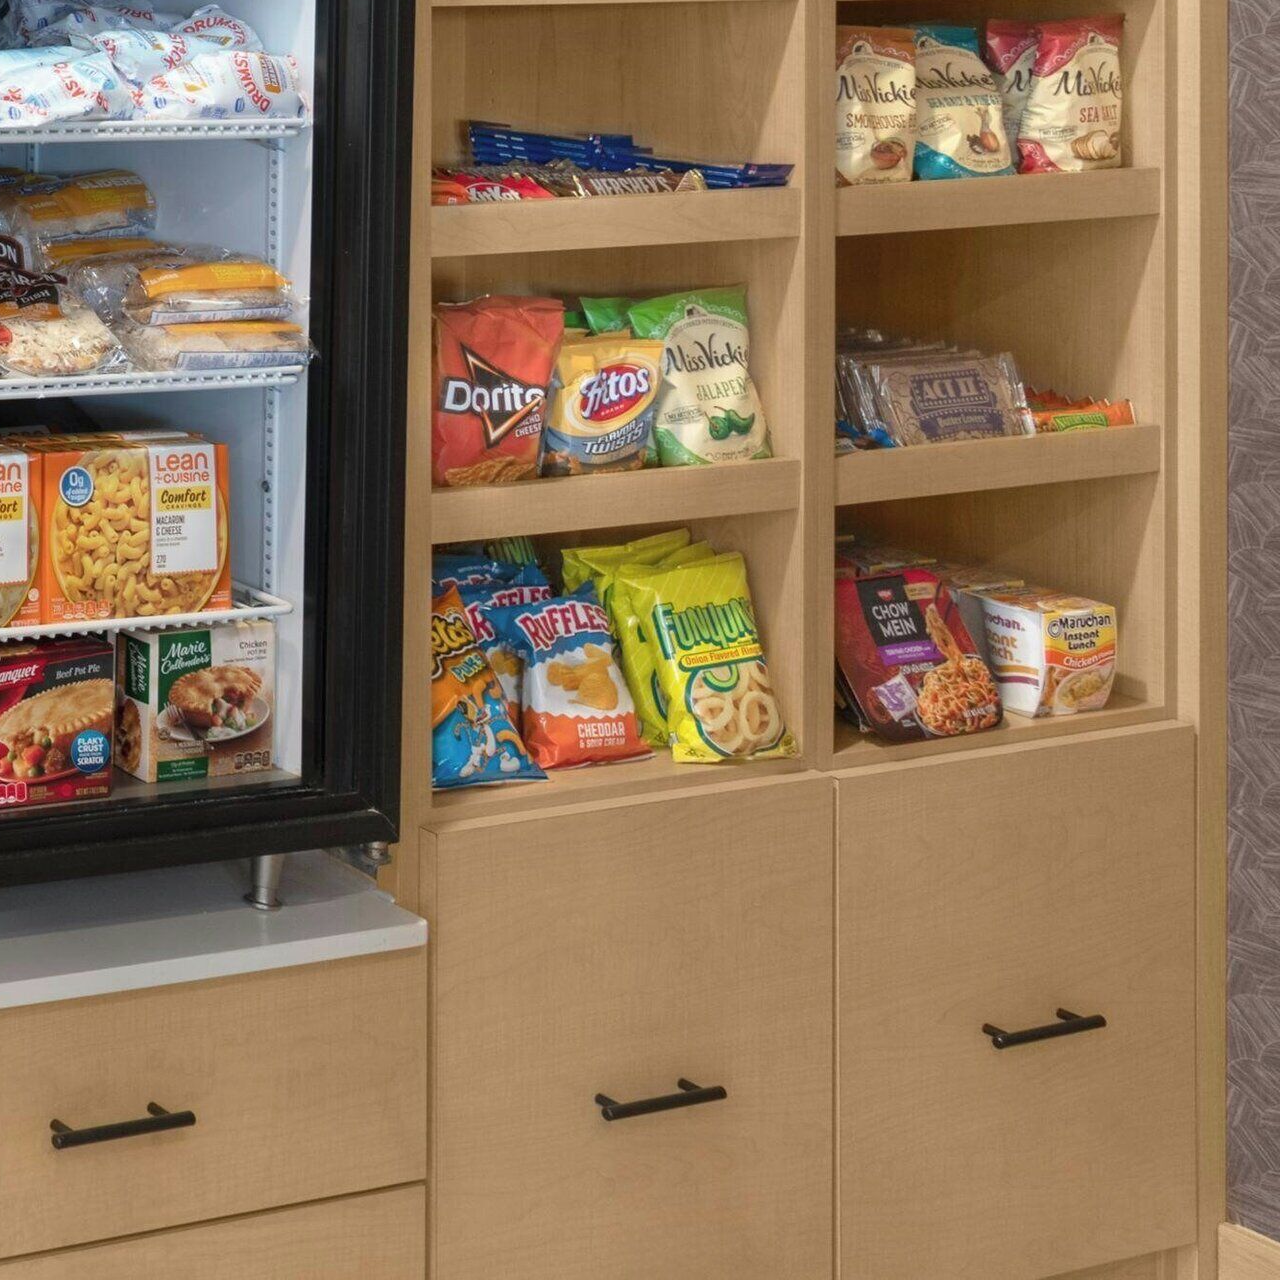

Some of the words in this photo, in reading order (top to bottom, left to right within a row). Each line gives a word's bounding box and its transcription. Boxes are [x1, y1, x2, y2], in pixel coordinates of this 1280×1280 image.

[864, 72, 916, 109] Vickie
[593, 175, 673, 197] HERSHEY'S
[695, 332, 749, 370] Vickie
[444, 380, 544, 412] Dorito
[580, 367, 650, 419] Fritos
[155, 452, 208, 472] Lean
[69, 472, 84, 487] 0g
[160, 489, 207, 504] Comfort
[161, 525, 182, 536] CHEESE
[871, 602, 910, 620] CHOW
[515, 601, 611, 651] RUFFLES
[878, 617, 918, 639] MEIN
[1059, 614, 1111, 630] Maruchan
[1064, 630, 1100, 641] Instant
[162, 641, 207, 661] Marie
[239, 639, 268, 650] Chicken
[1068, 641, 1096, 650] Lunch
[684, 654, 709, 666] Onion
[1063, 655, 1099, 668] Chicken
[55, 667, 73, 680] Beef
[74, 665, 87, 676] Pot
[88, 664, 101, 673] Pie
[577, 722, 626, 739] CHEDDAR
[77, 736, 104, 746] FLAKY
[77, 744, 104, 753] CRUST
